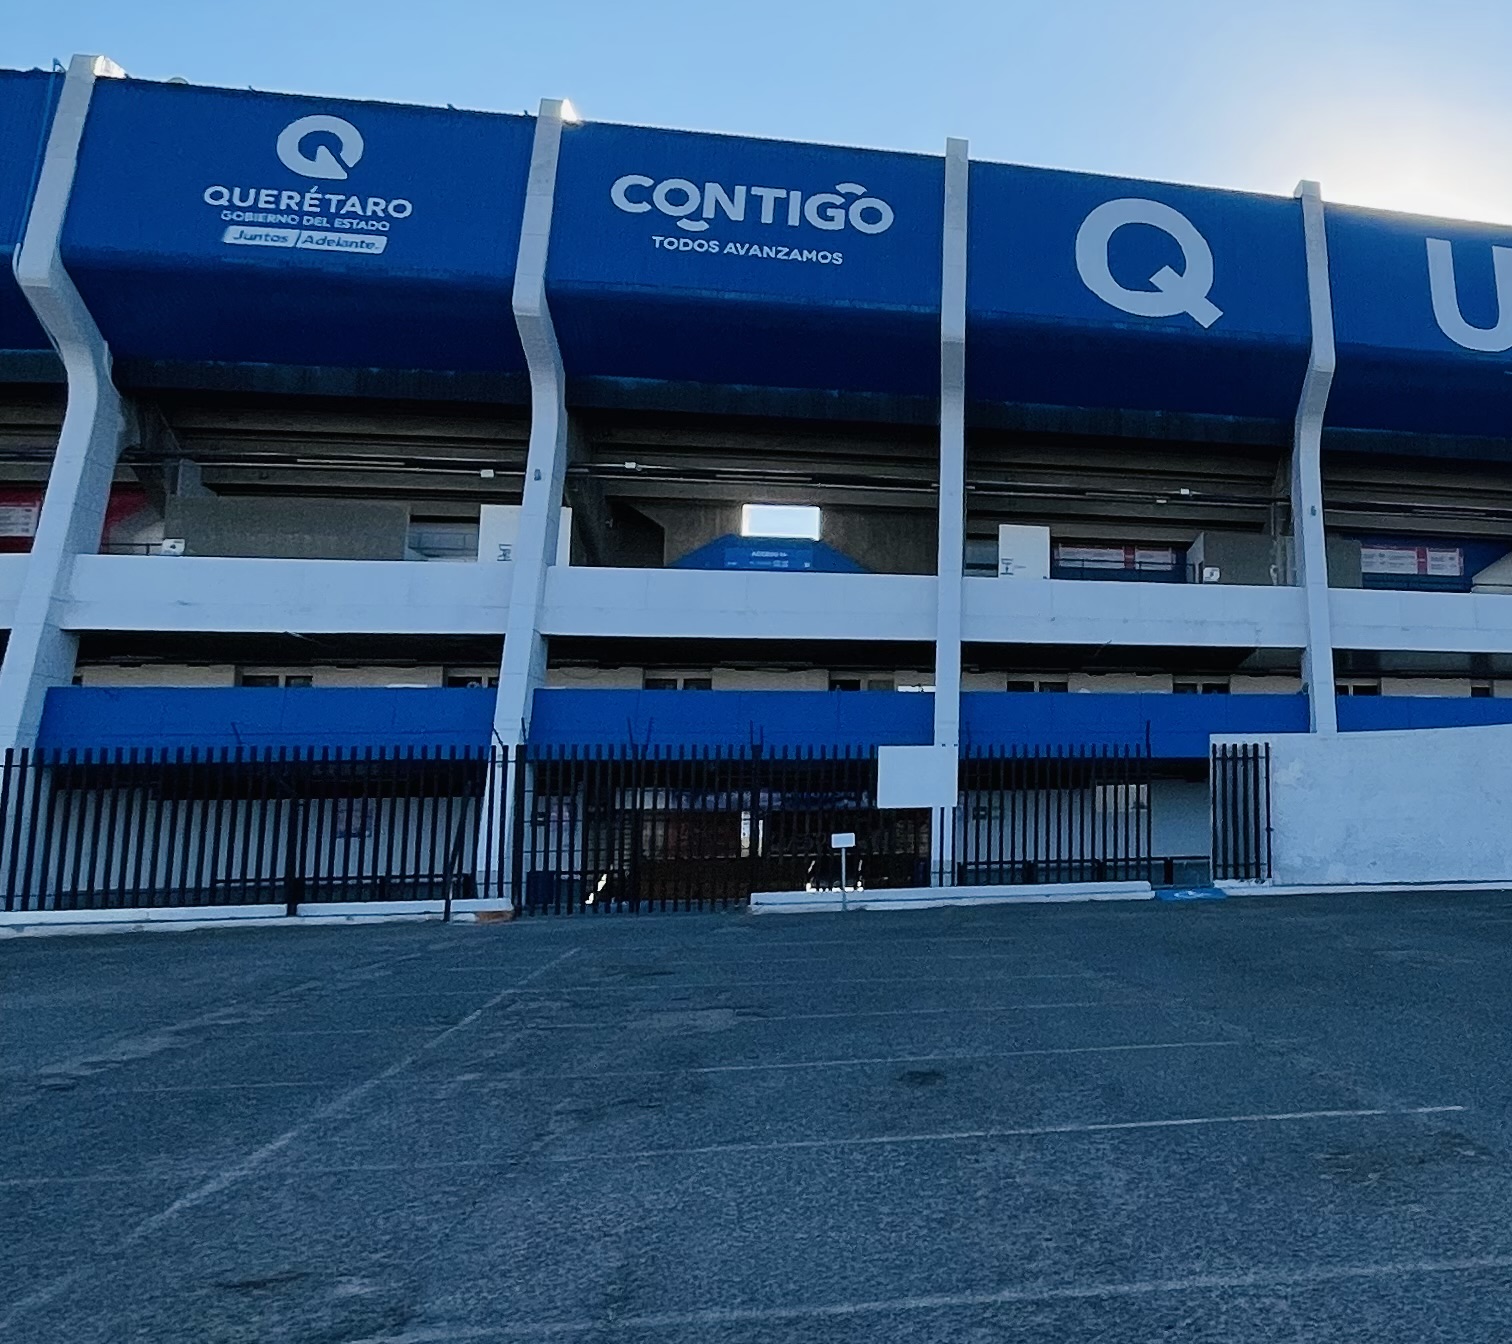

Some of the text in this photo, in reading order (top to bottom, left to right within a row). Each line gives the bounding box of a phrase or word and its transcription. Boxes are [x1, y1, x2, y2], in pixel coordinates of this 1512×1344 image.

[203, 185, 413, 219] QUERÉTARO
[610, 174, 895, 234] CONTIGO
[220, 210, 390, 232] GOBIERNO DEL ESTADO
[232, 229, 290, 244] Juntos
[652, 235, 844, 265] TODOS AVANZAMOS
